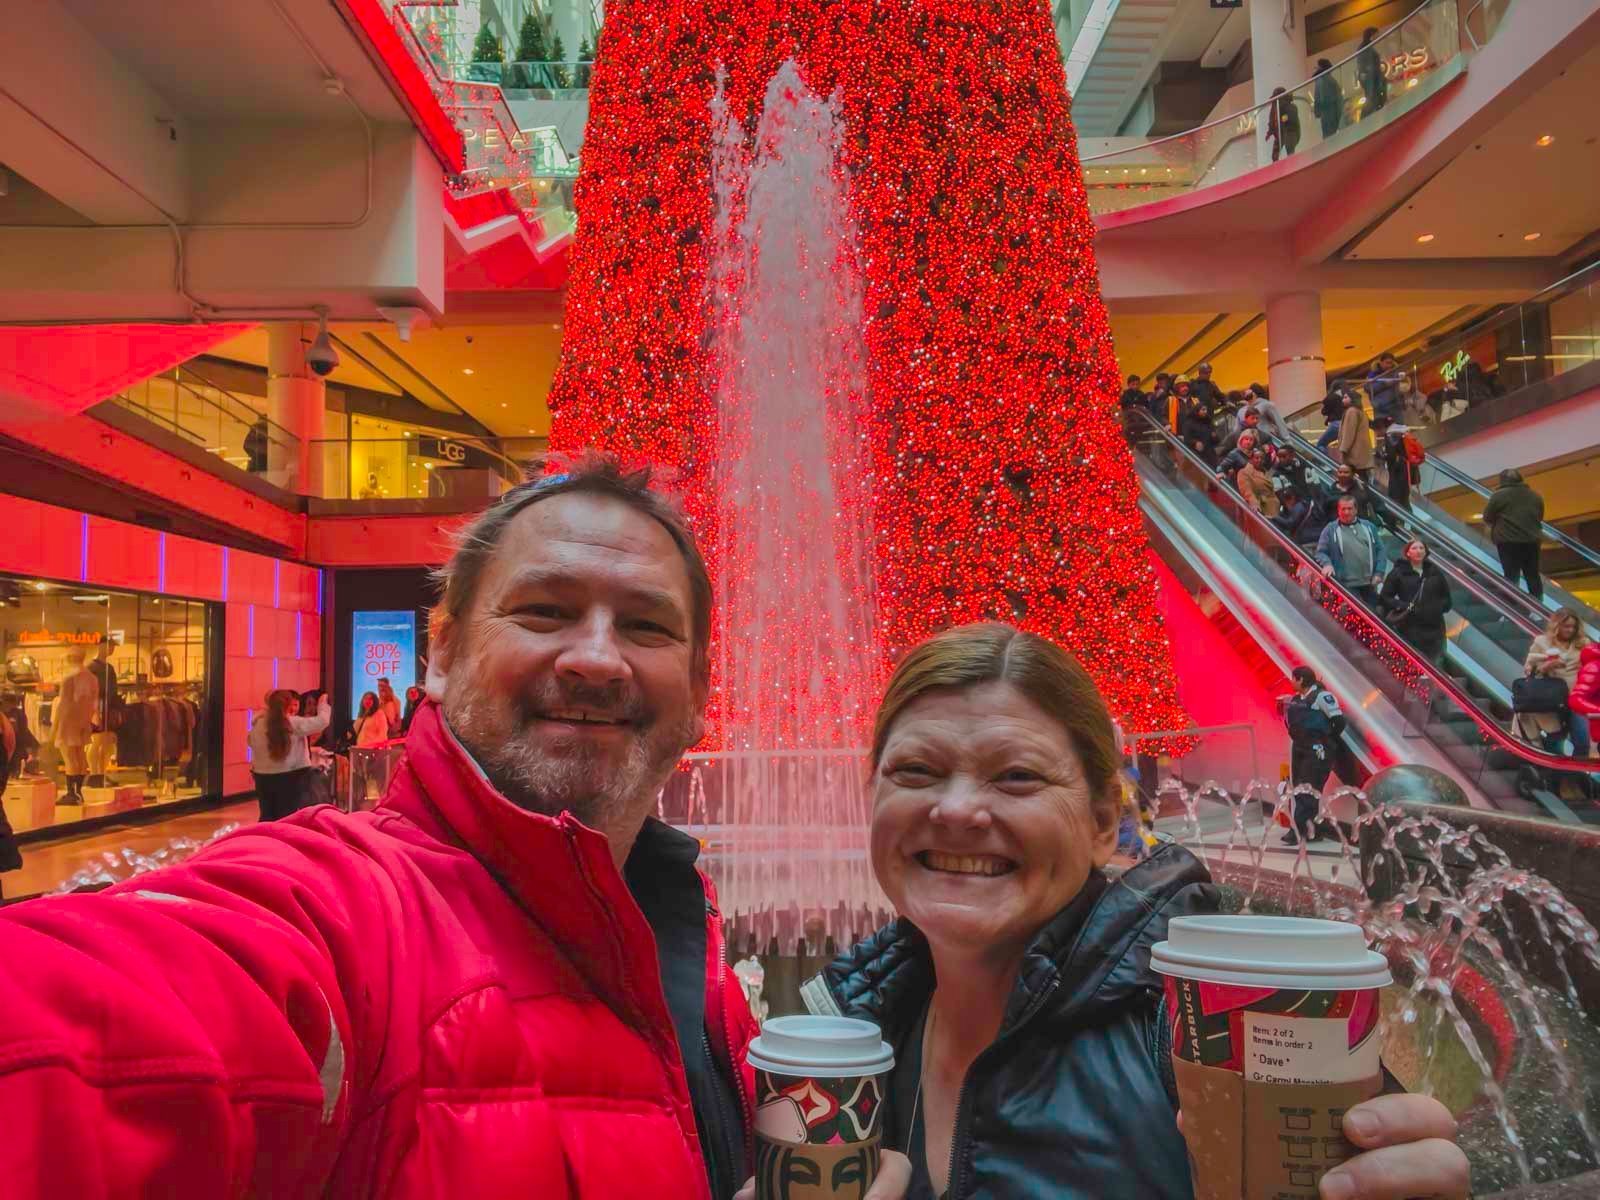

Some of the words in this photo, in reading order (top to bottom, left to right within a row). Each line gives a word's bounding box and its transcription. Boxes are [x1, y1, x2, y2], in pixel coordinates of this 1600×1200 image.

[437, 440, 465, 461] UGG
[365, 642, 401, 659] 30%
[365, 660, 401, 676] OFF
[1182, 980, 1202, 1065] STARBUCK
[1273, 1027, 1279, 1036] 2
[1280, 1029, 1288, 1037] of
[1288, 1030, 1294, 1038] 2
[1252, 1035, 1274, 1046] Items
[1275, 1038, 1283, 1047] in
[1308, 1041, 1313, 1050] 2
[1259, 1053, 1284, 1067] Dave
[1253, 1071, 1264, 1081] Gr
